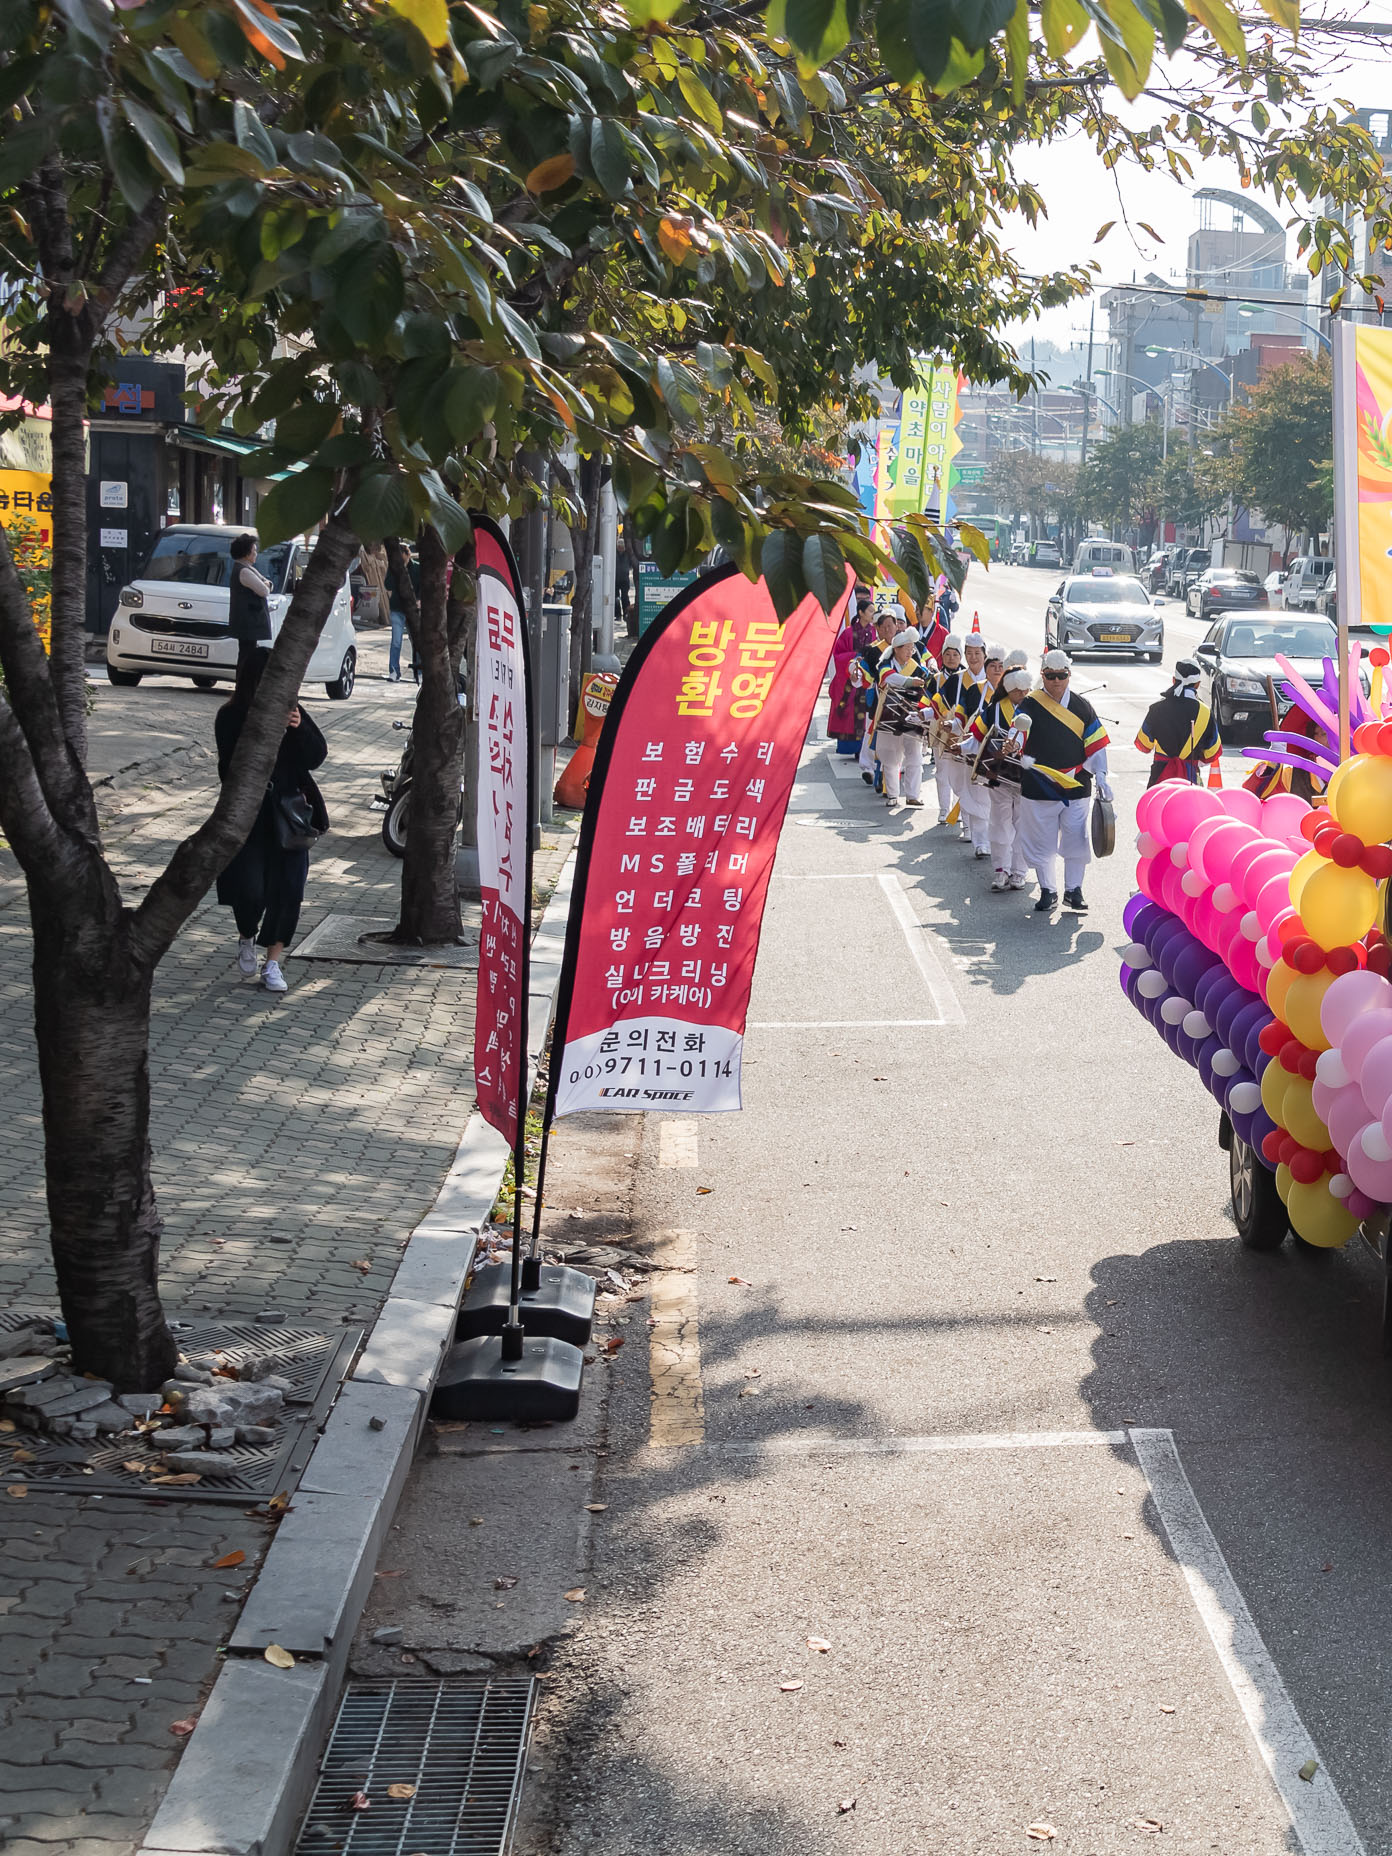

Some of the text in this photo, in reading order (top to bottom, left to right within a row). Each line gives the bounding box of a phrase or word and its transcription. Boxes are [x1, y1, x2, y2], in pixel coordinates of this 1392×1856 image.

[688, 620, 787, 668] 방문
[675, 670, 775, 719] 환영
[600, 1028, 707, 1053] 문의전화
